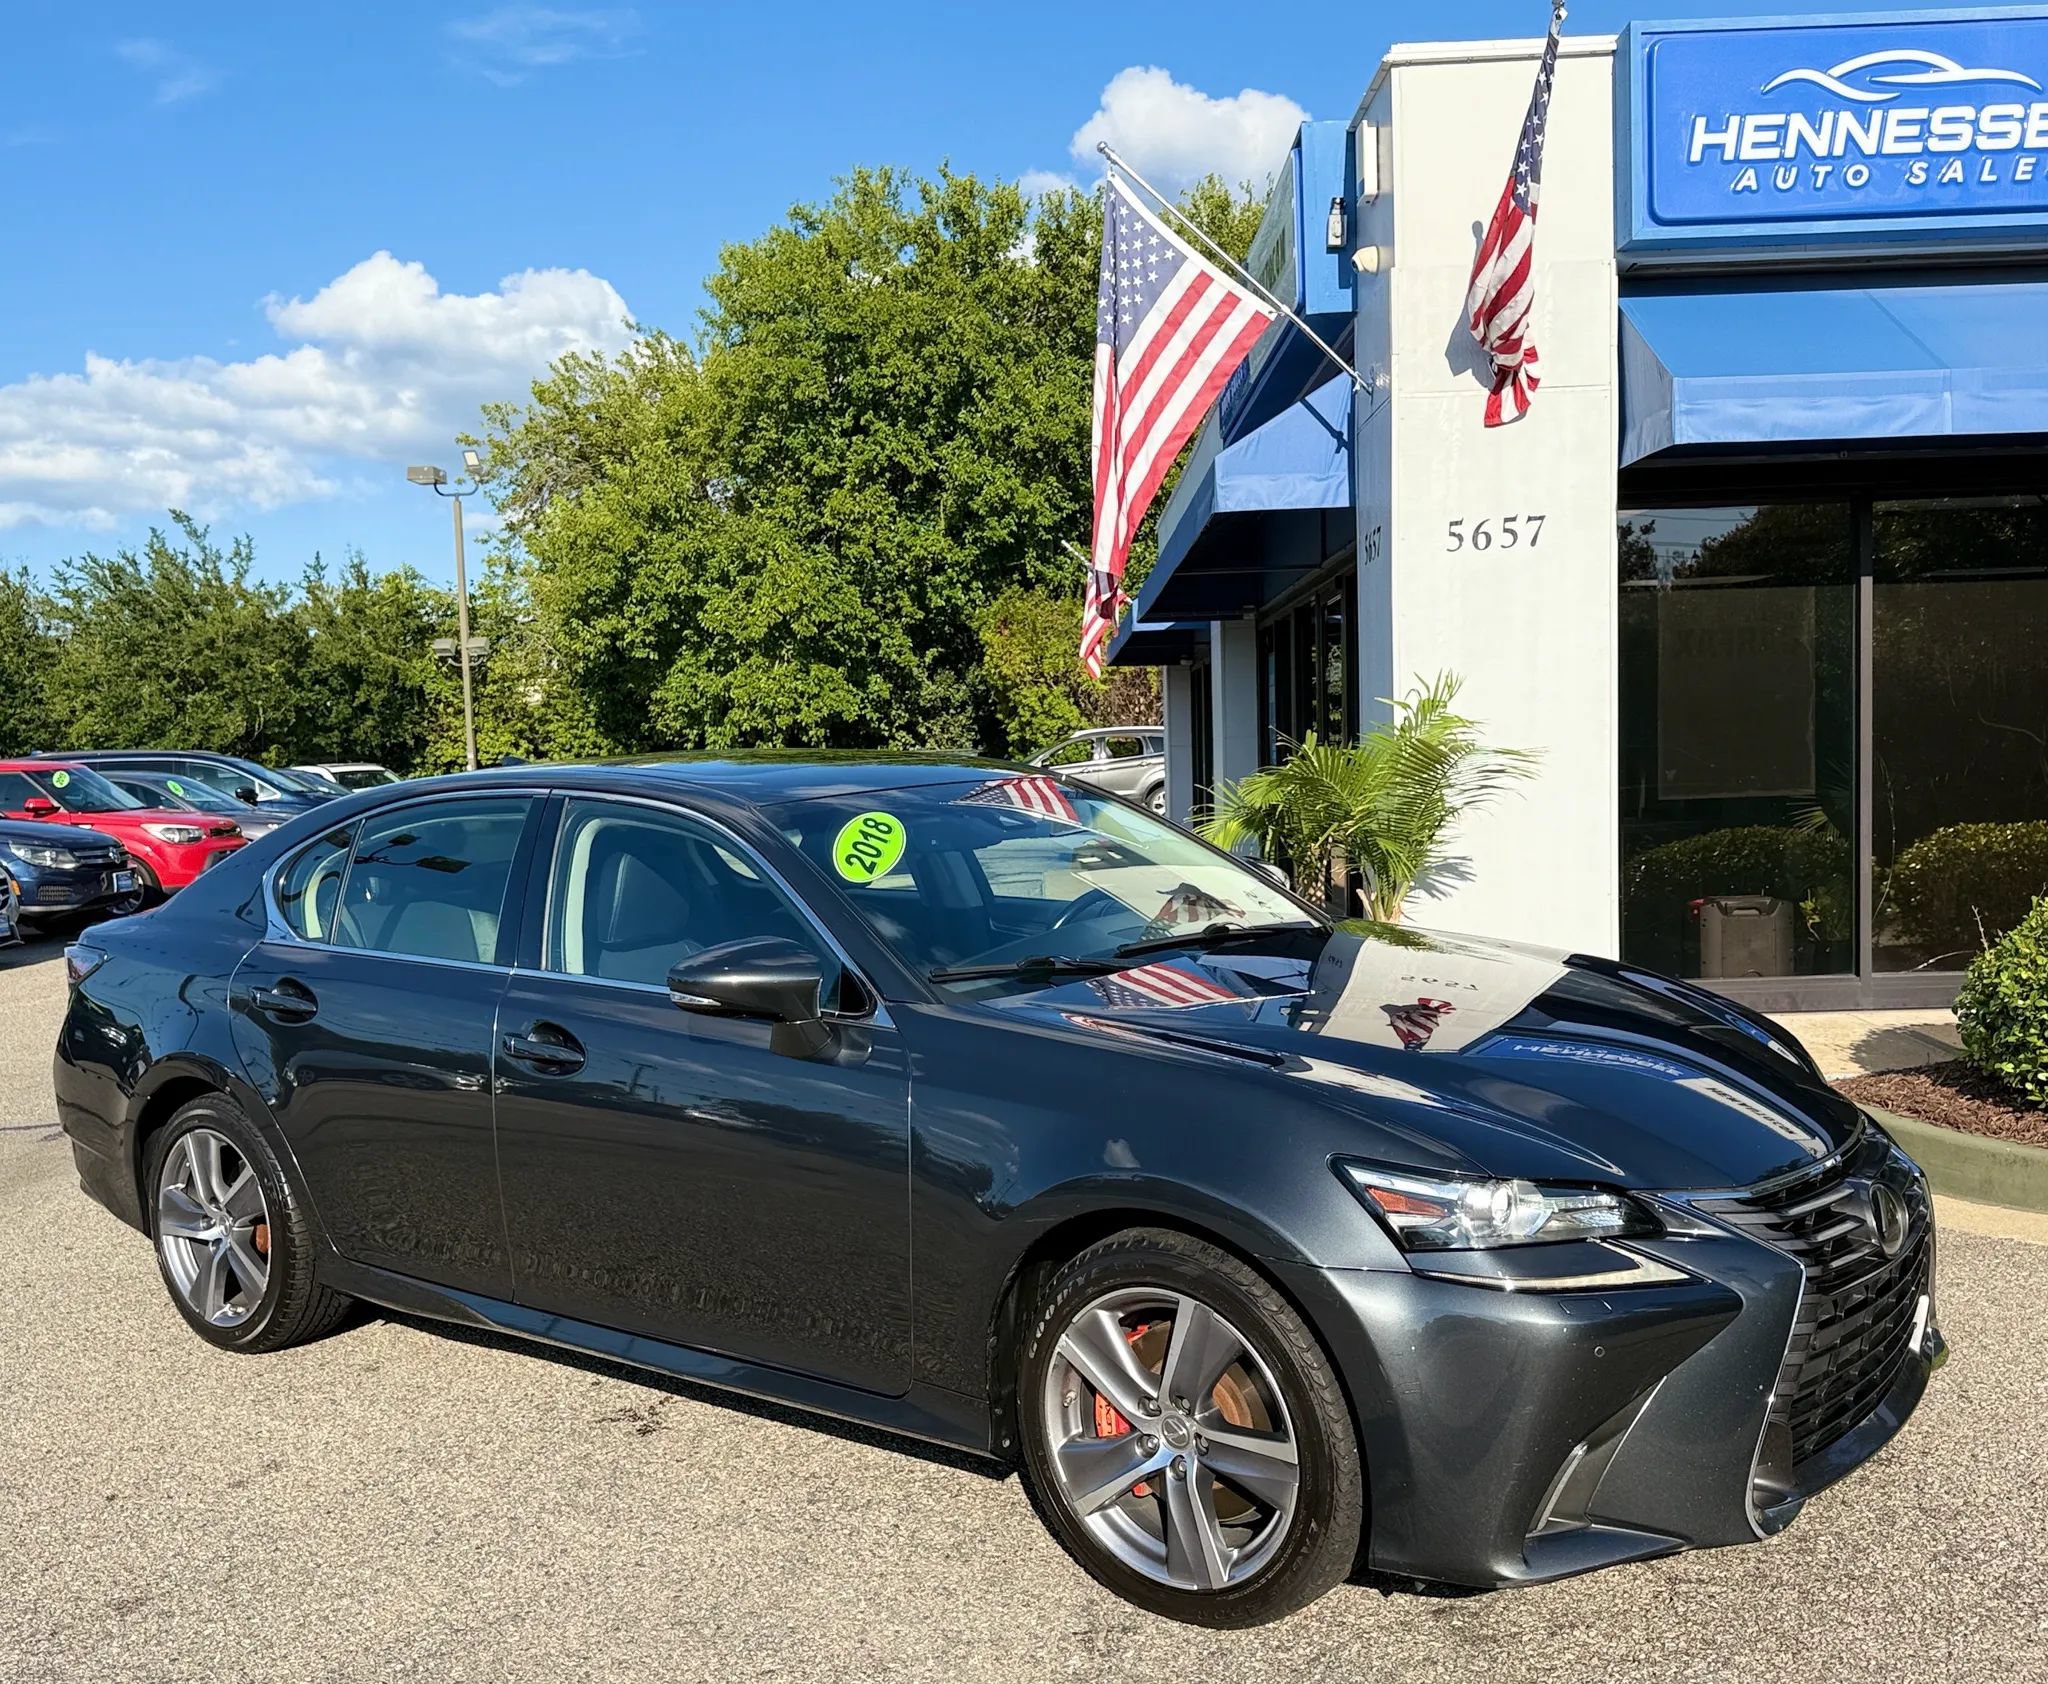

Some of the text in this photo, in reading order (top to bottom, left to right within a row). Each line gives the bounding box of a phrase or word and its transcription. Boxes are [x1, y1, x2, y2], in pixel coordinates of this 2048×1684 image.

[1689, 102, 2048, 162] HENNESSE
[1734, 157, 2037, 191] AUTO SALE
[1364, 525, 1382, 566] 5657
[1446, 514, 1547, 552] 5657
[845, 817, 893, 875] 2018
